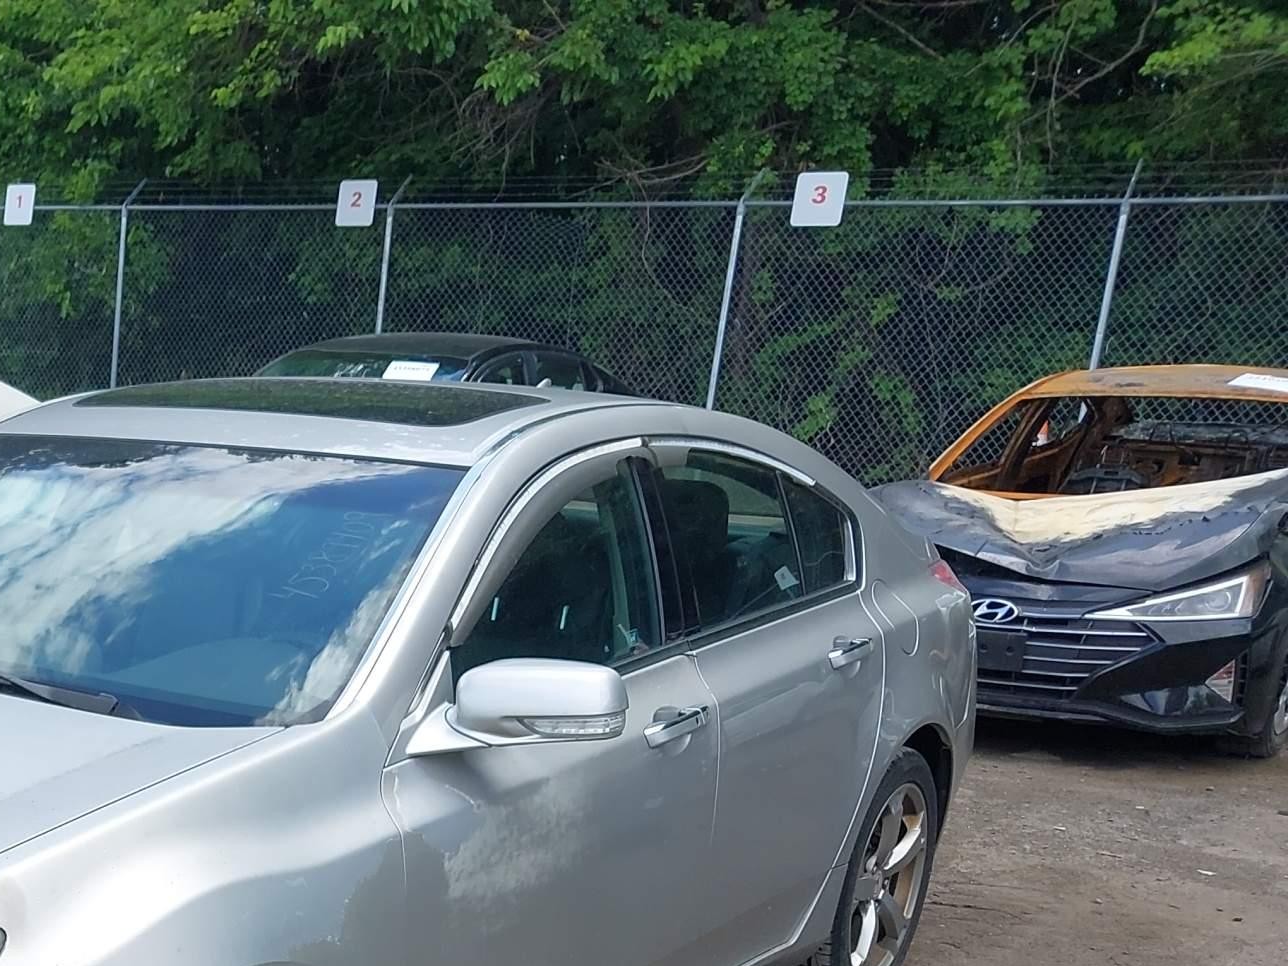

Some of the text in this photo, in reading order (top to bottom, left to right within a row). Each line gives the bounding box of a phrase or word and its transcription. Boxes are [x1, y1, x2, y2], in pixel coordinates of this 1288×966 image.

[16, 194, 23, 209] 1
[350, 191, 363, 208] 2
[811, 185, 828, 204] 3
